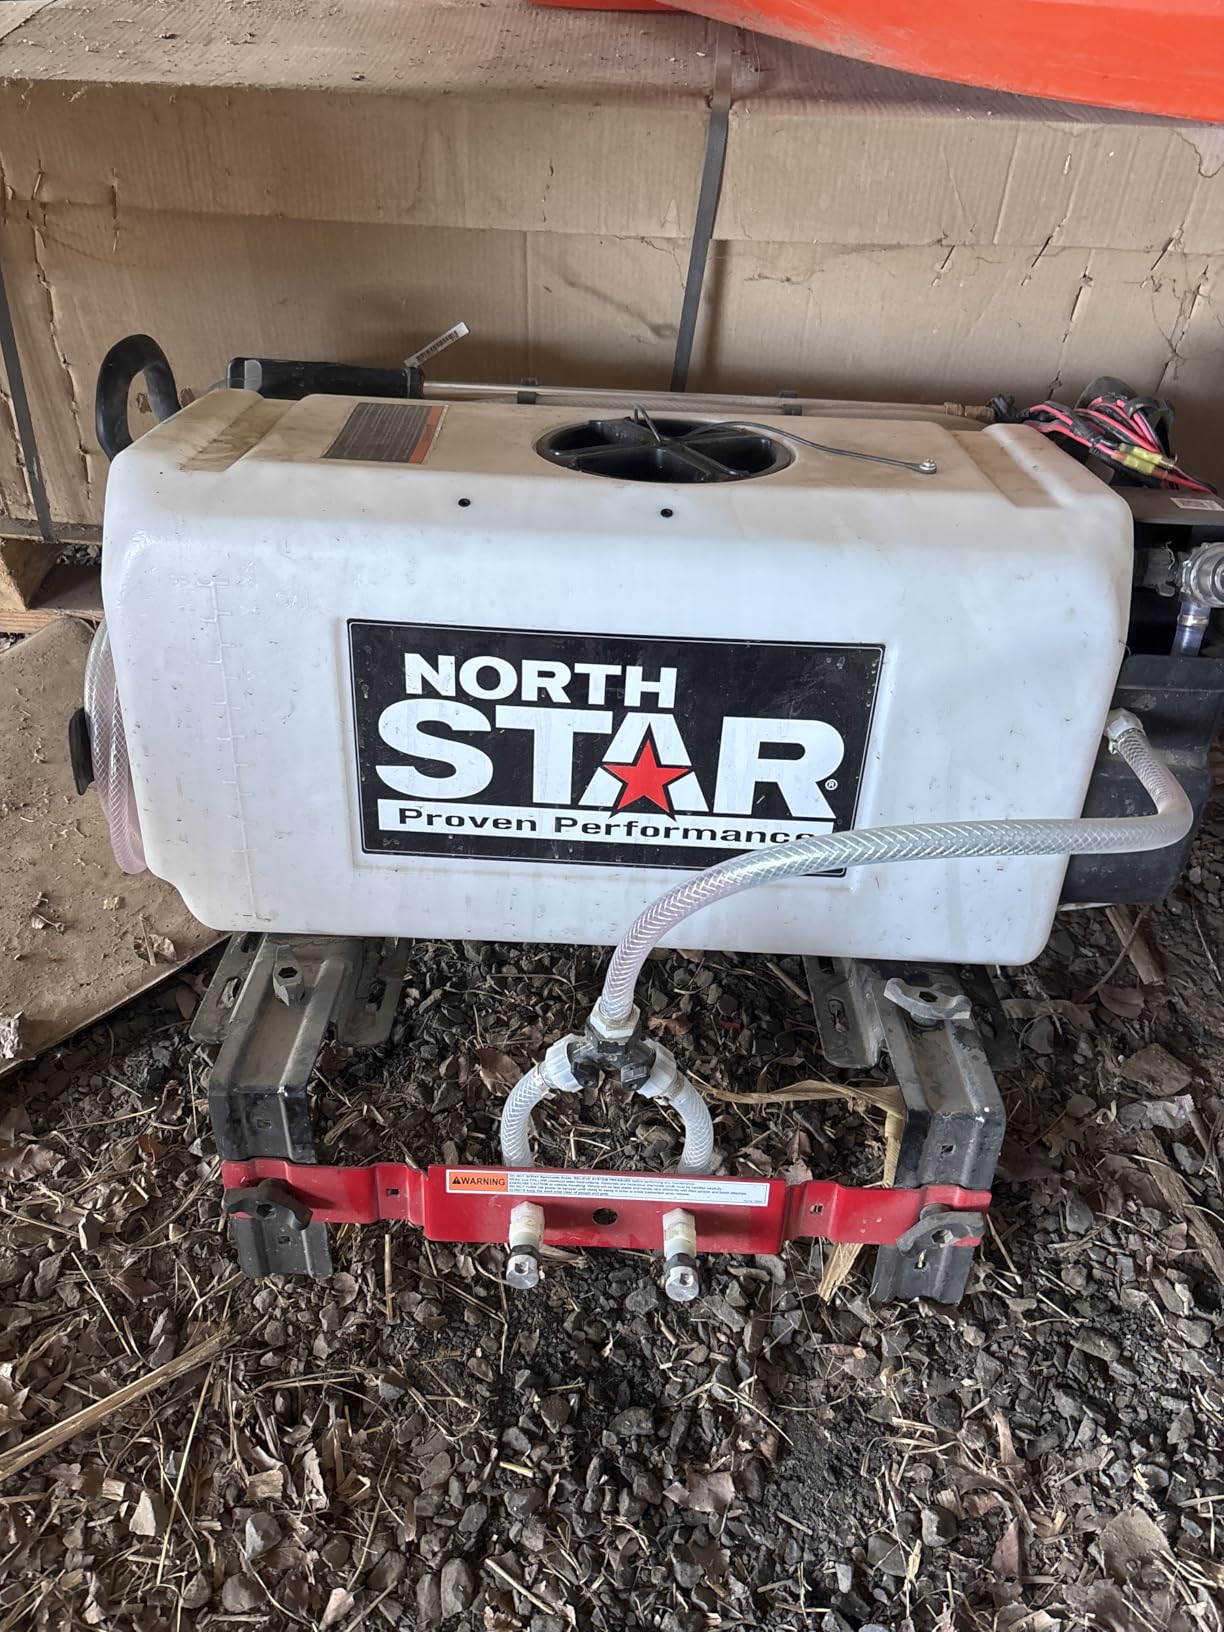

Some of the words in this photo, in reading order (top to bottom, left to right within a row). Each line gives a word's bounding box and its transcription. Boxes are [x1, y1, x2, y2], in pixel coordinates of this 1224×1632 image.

[404, 652, 678, 709] NORTH
[399, 807, 538, 832] Proven
[460, 1176, 505, 1186] WARNING
